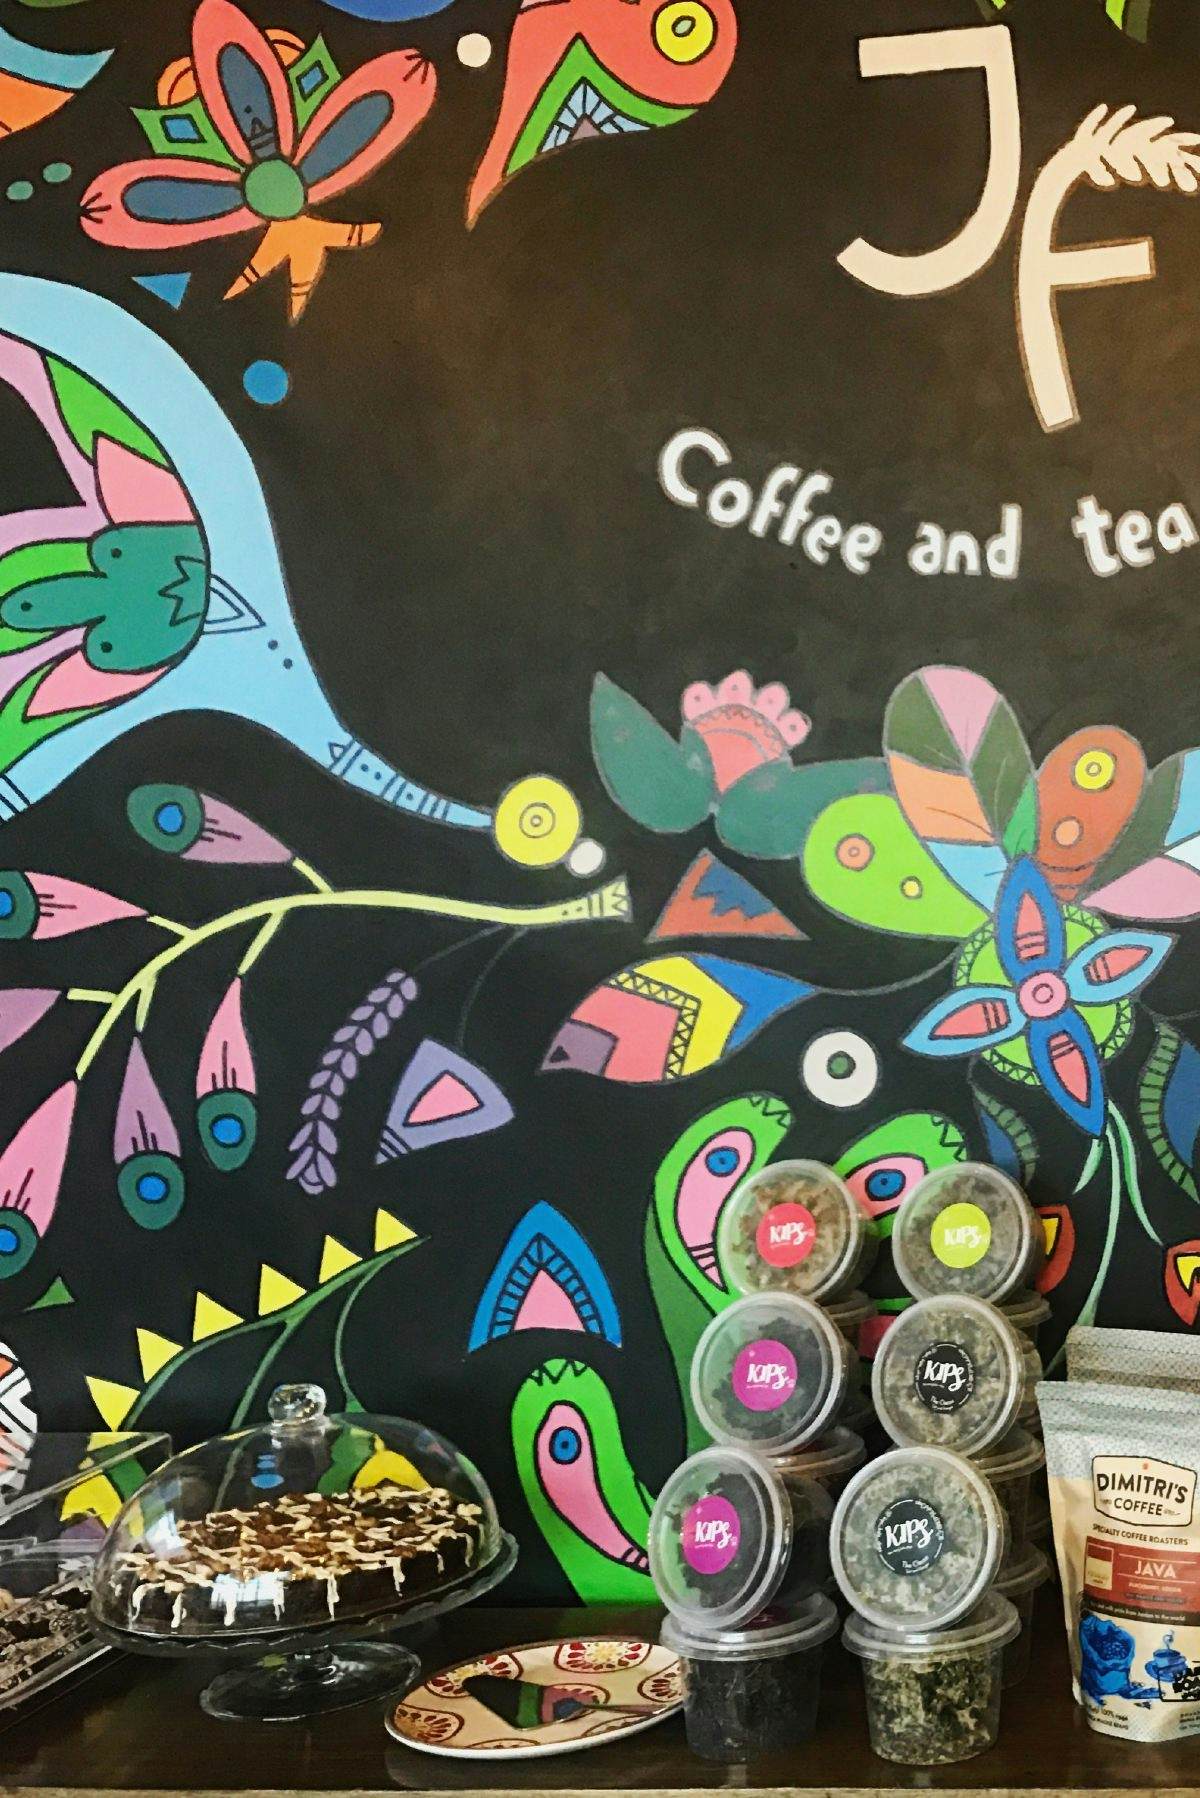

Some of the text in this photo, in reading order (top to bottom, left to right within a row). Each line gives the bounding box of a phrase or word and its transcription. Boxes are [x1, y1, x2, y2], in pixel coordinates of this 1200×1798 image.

[660, 429, 881, 573] Coffee
[910, 503, 1021, 578] and
[1075, 496, 1197, 578] tea
[1096, 1472, 1189, 1504] DIMITRI'S
[1113, 1497, 1164, 1516] COFFEE
[1092, 1523, 1189, 1546] SPECIALTY COFFEE ROASTERS
[1134, 1560, 1177, 1579] JAVA
